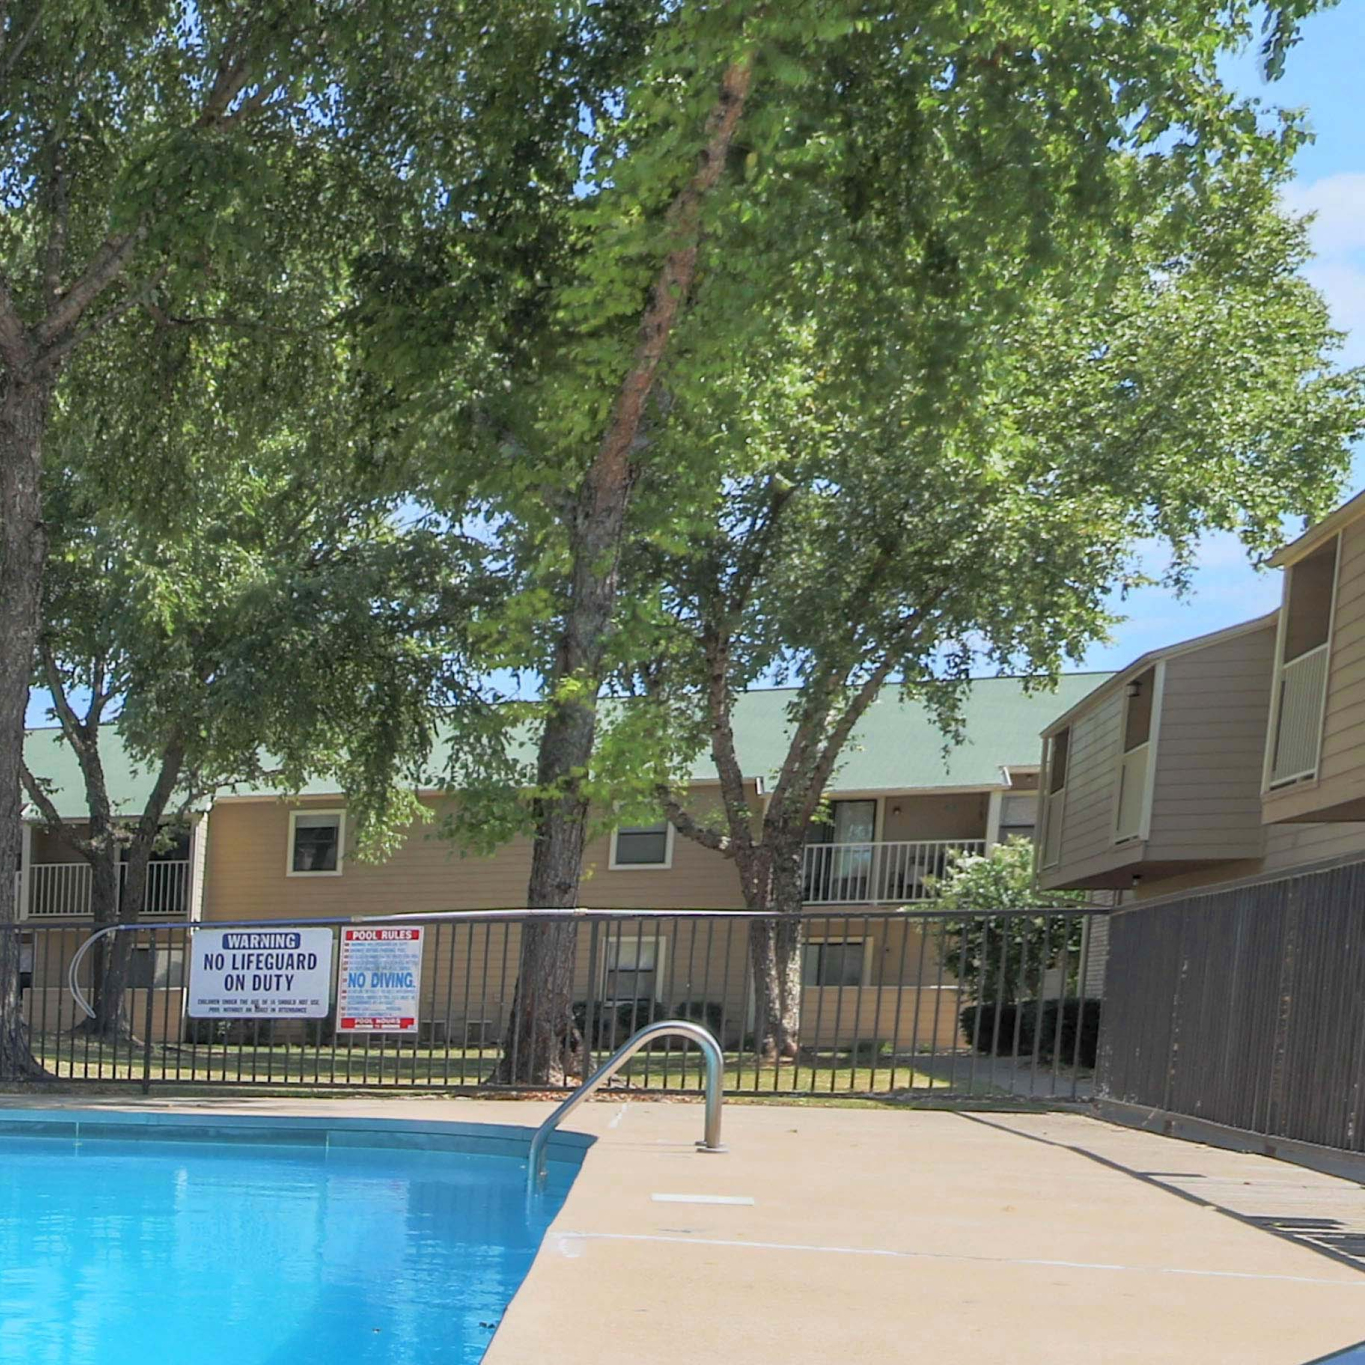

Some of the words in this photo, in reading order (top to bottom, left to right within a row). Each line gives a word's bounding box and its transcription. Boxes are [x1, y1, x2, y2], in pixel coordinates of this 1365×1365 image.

[227, 933, 296, 949] WARNING
[352, 931, 377, 940] POOL
[381, 930, 412, 940] RULES
[203, 953, 225, 971] NO
[231, 953, 318, 971] LIFEGUARD
[224, 974, 245, 991] ON
[252, 974, 294, 991] DUTY
[348, 972, 366, 988] NO
